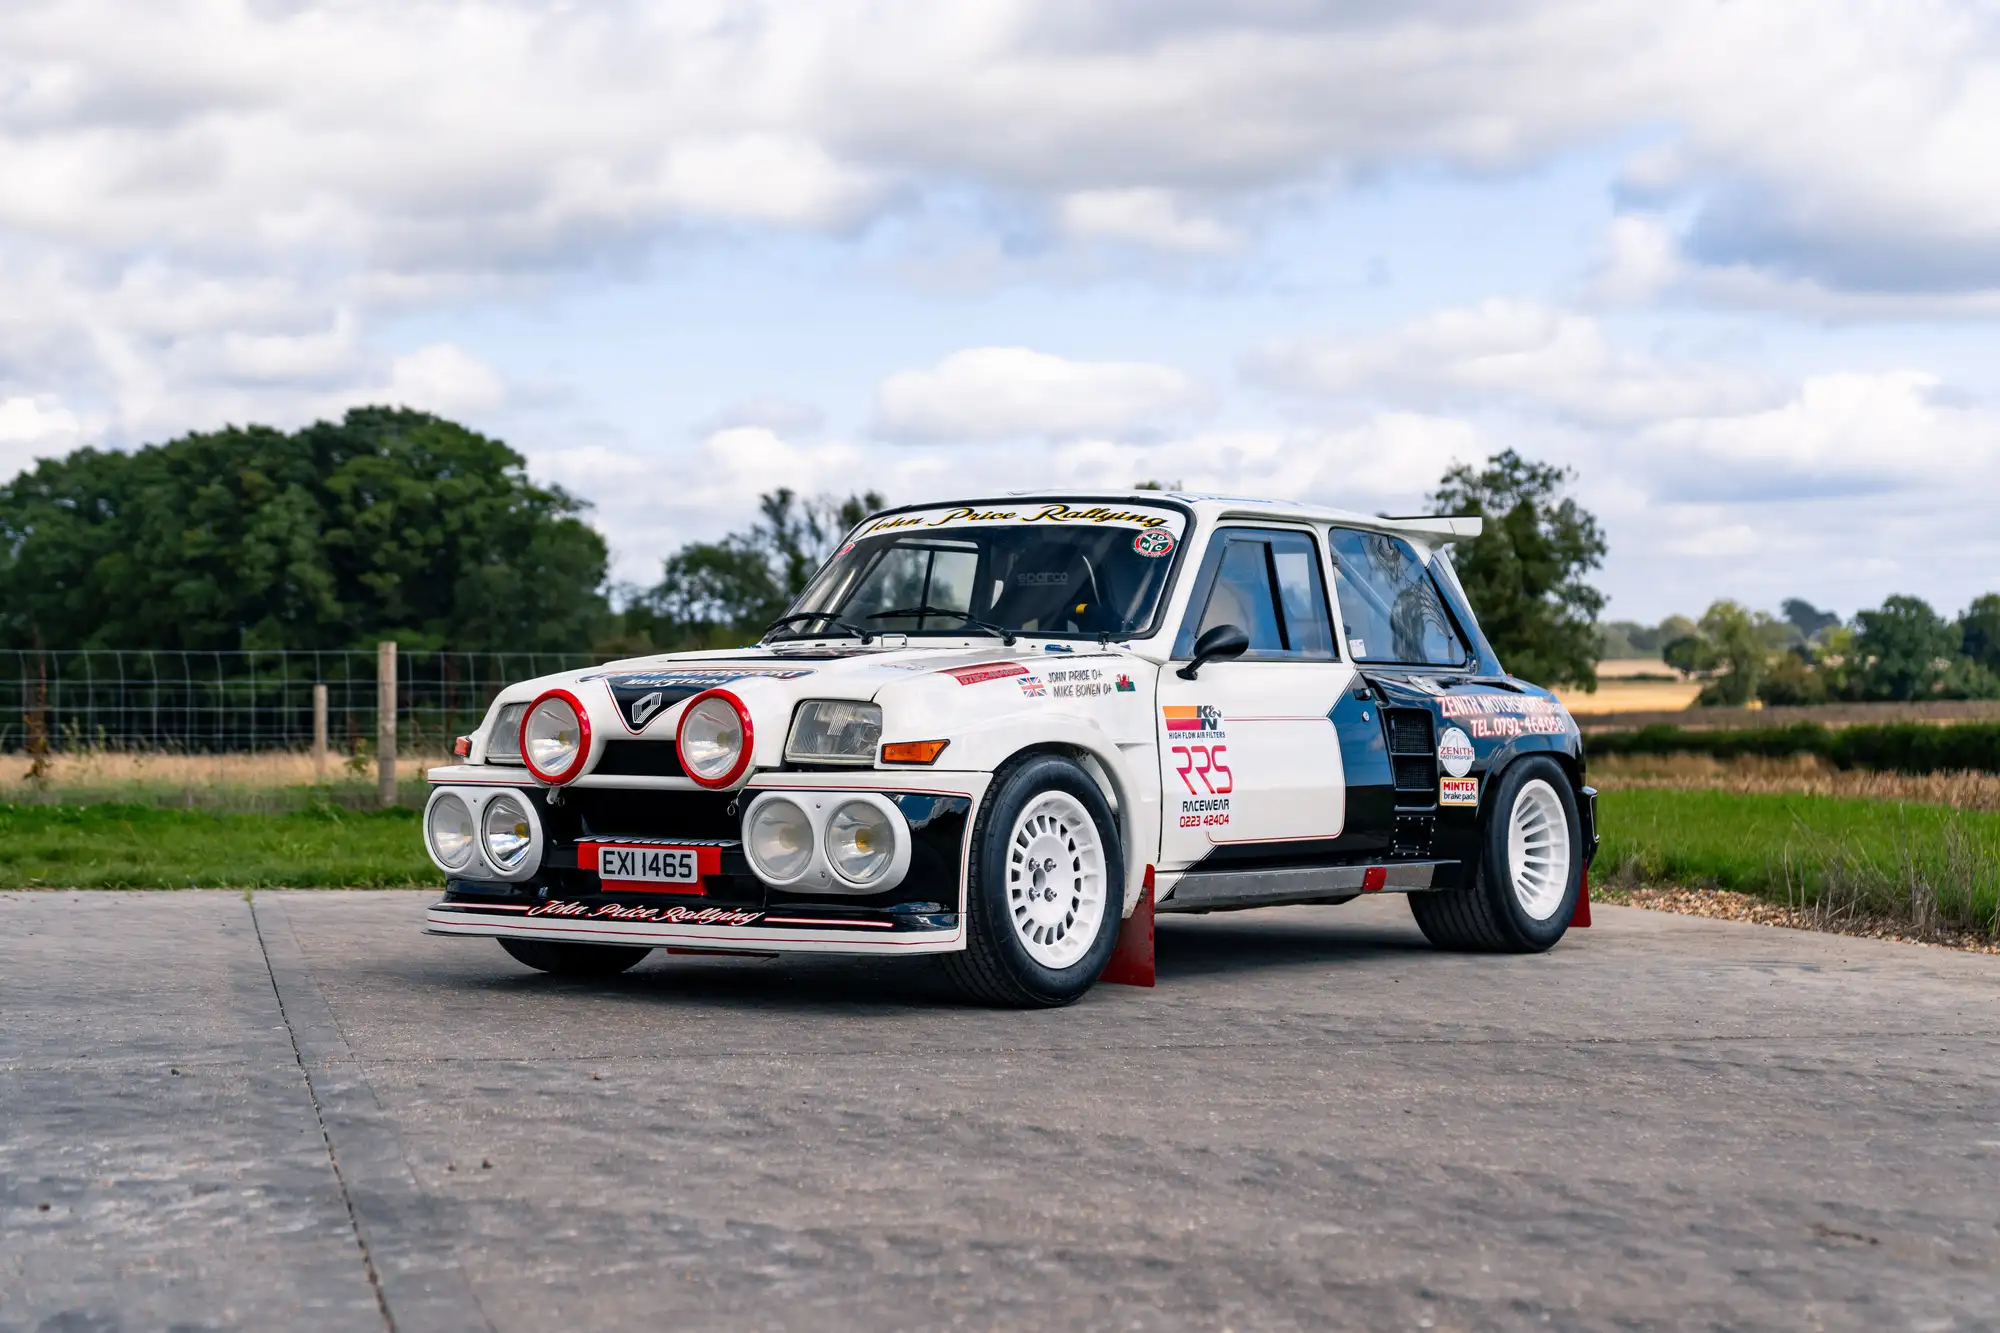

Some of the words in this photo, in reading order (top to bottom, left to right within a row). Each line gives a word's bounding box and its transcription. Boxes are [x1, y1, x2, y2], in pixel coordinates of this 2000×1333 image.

[856, 515, 924, 539] John
[926, 507, 1018, 527] Price
[1020, 504, 1169, 527] Rallying
[1017, 571, 1069, 586] sparco
[1047, 671, 1066, 684] JOHN
[1069, 669, 1091, 682] PRICE
[1053, 685, 1073, 698] MIKE
[1075, 684, 1101, 697] BOWEN
[1436, 695, 1482, 718] ZENITH
[1168, 732, 1182, 740] HIGH
[1182, 731, 1195, 739] FLOW
[1197, 731, 1205, 739] AIR
[1206, 731, 1226, 739] FILTERS
[1439, 746, 1474, 755] ZENITH
[1443, 782, 1475, 792] MINTEX
[1443, 792, 1462, 800] brake
[1462, 792, 1476, 801] pads
[1182, 799, 1230, 812] RACEWEAR
[1179, 815, 1201, 828] 0223
[1203, 814, 1229, 826] 42404
[602, 850, 636, 876] EXI
[642, 852, 692, 879] 1465
[528, 900, 590, 918] John
[587, 903, 658, 919] Price
[652, 906, 766, 926] Rallying
